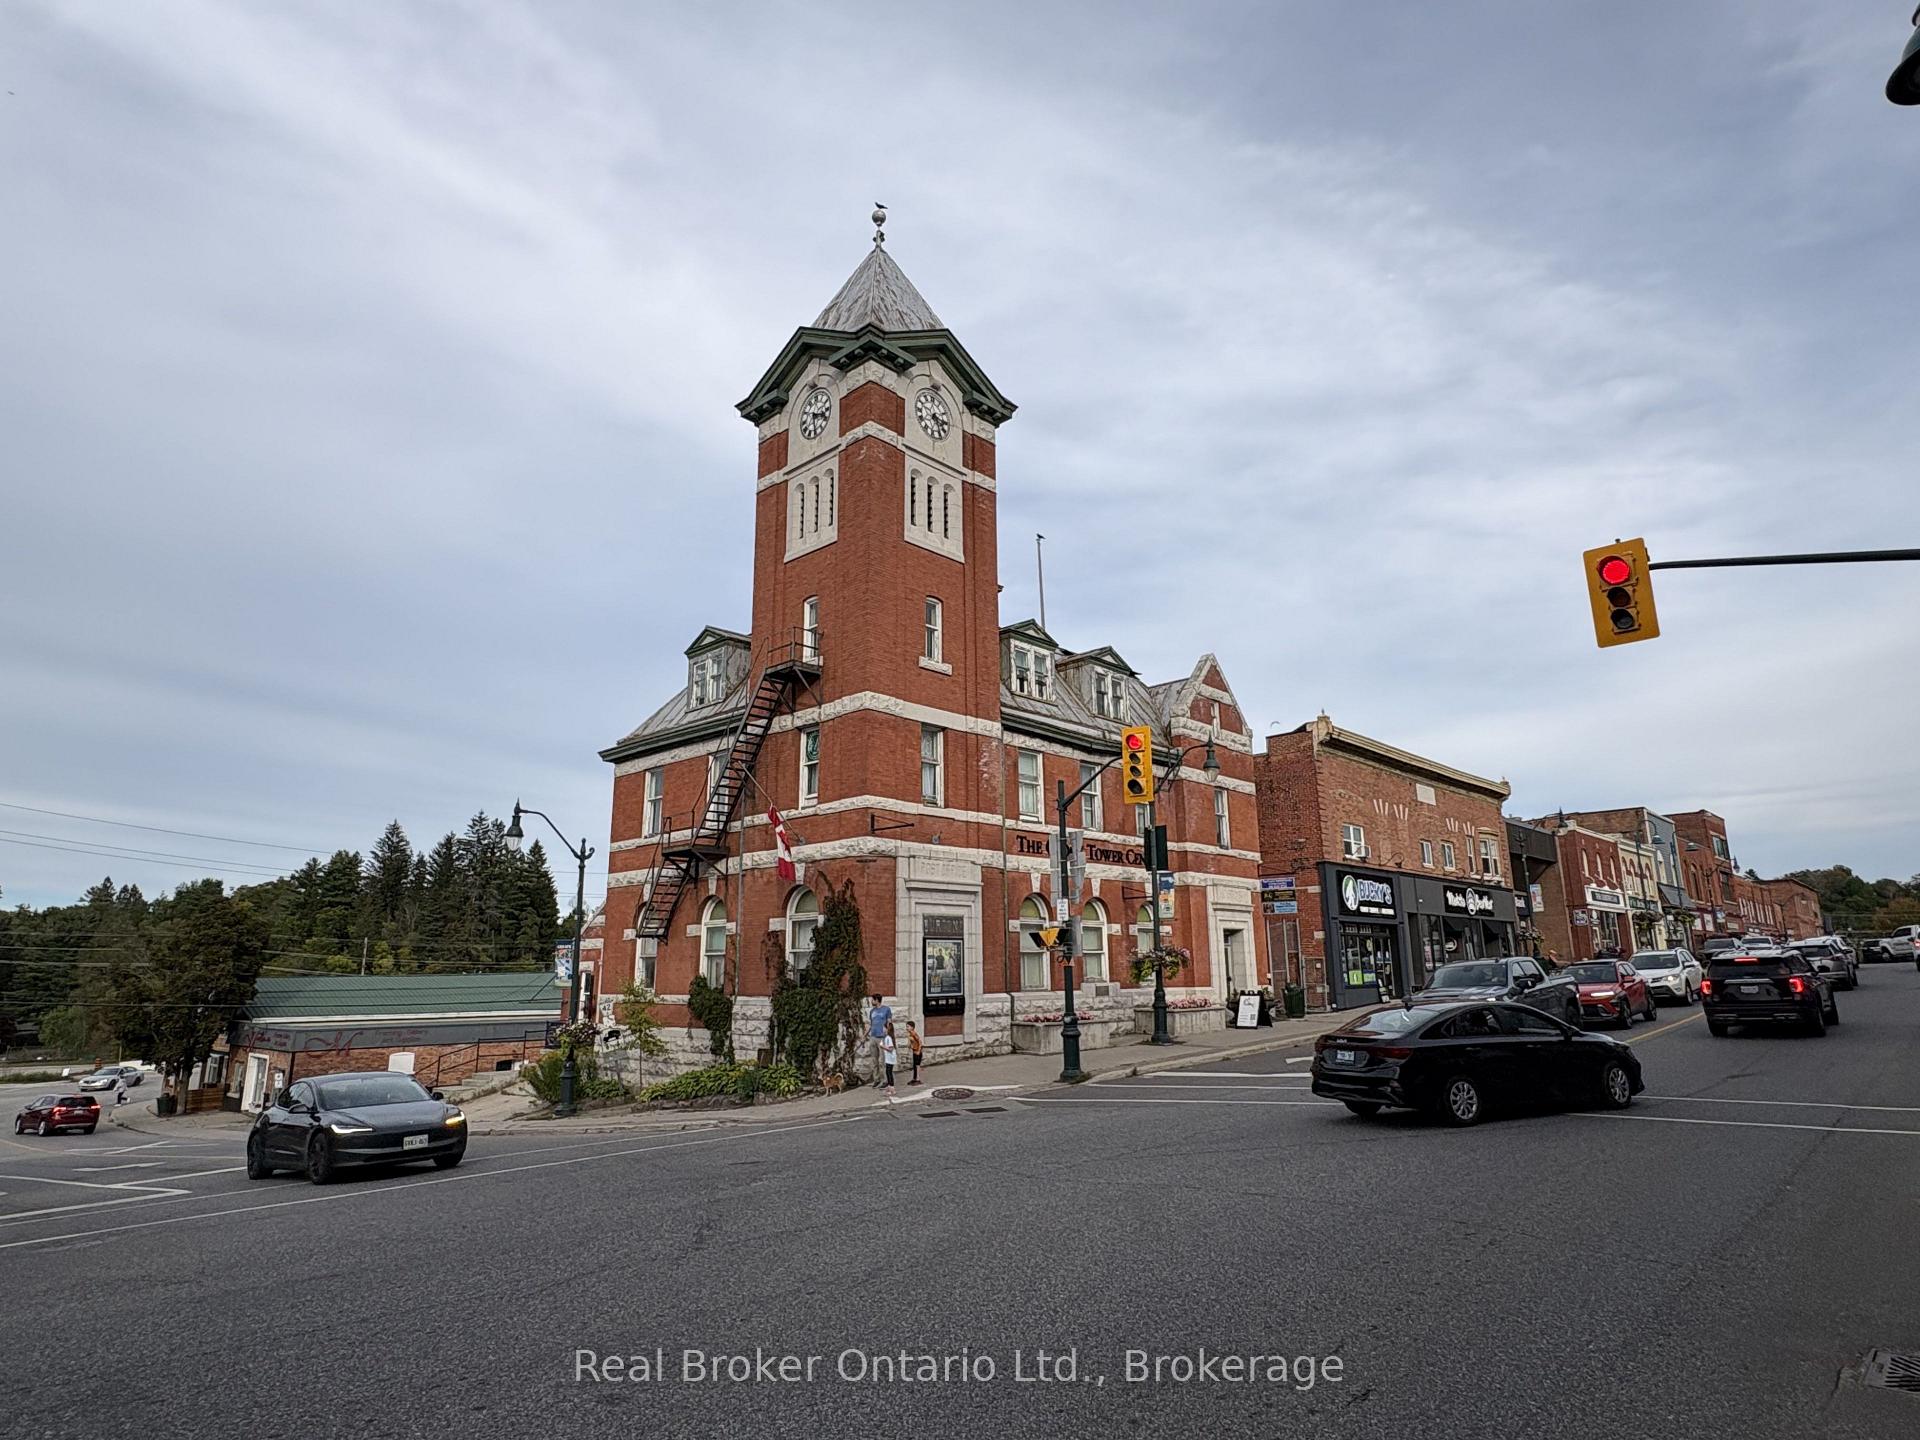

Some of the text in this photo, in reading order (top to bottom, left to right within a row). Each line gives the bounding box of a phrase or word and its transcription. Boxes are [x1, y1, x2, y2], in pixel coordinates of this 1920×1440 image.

[1016, 835, 1042, 854] THE
[1086, 843, 1124, 864] TOWER
[602, 1003, 611, 1012] 42
